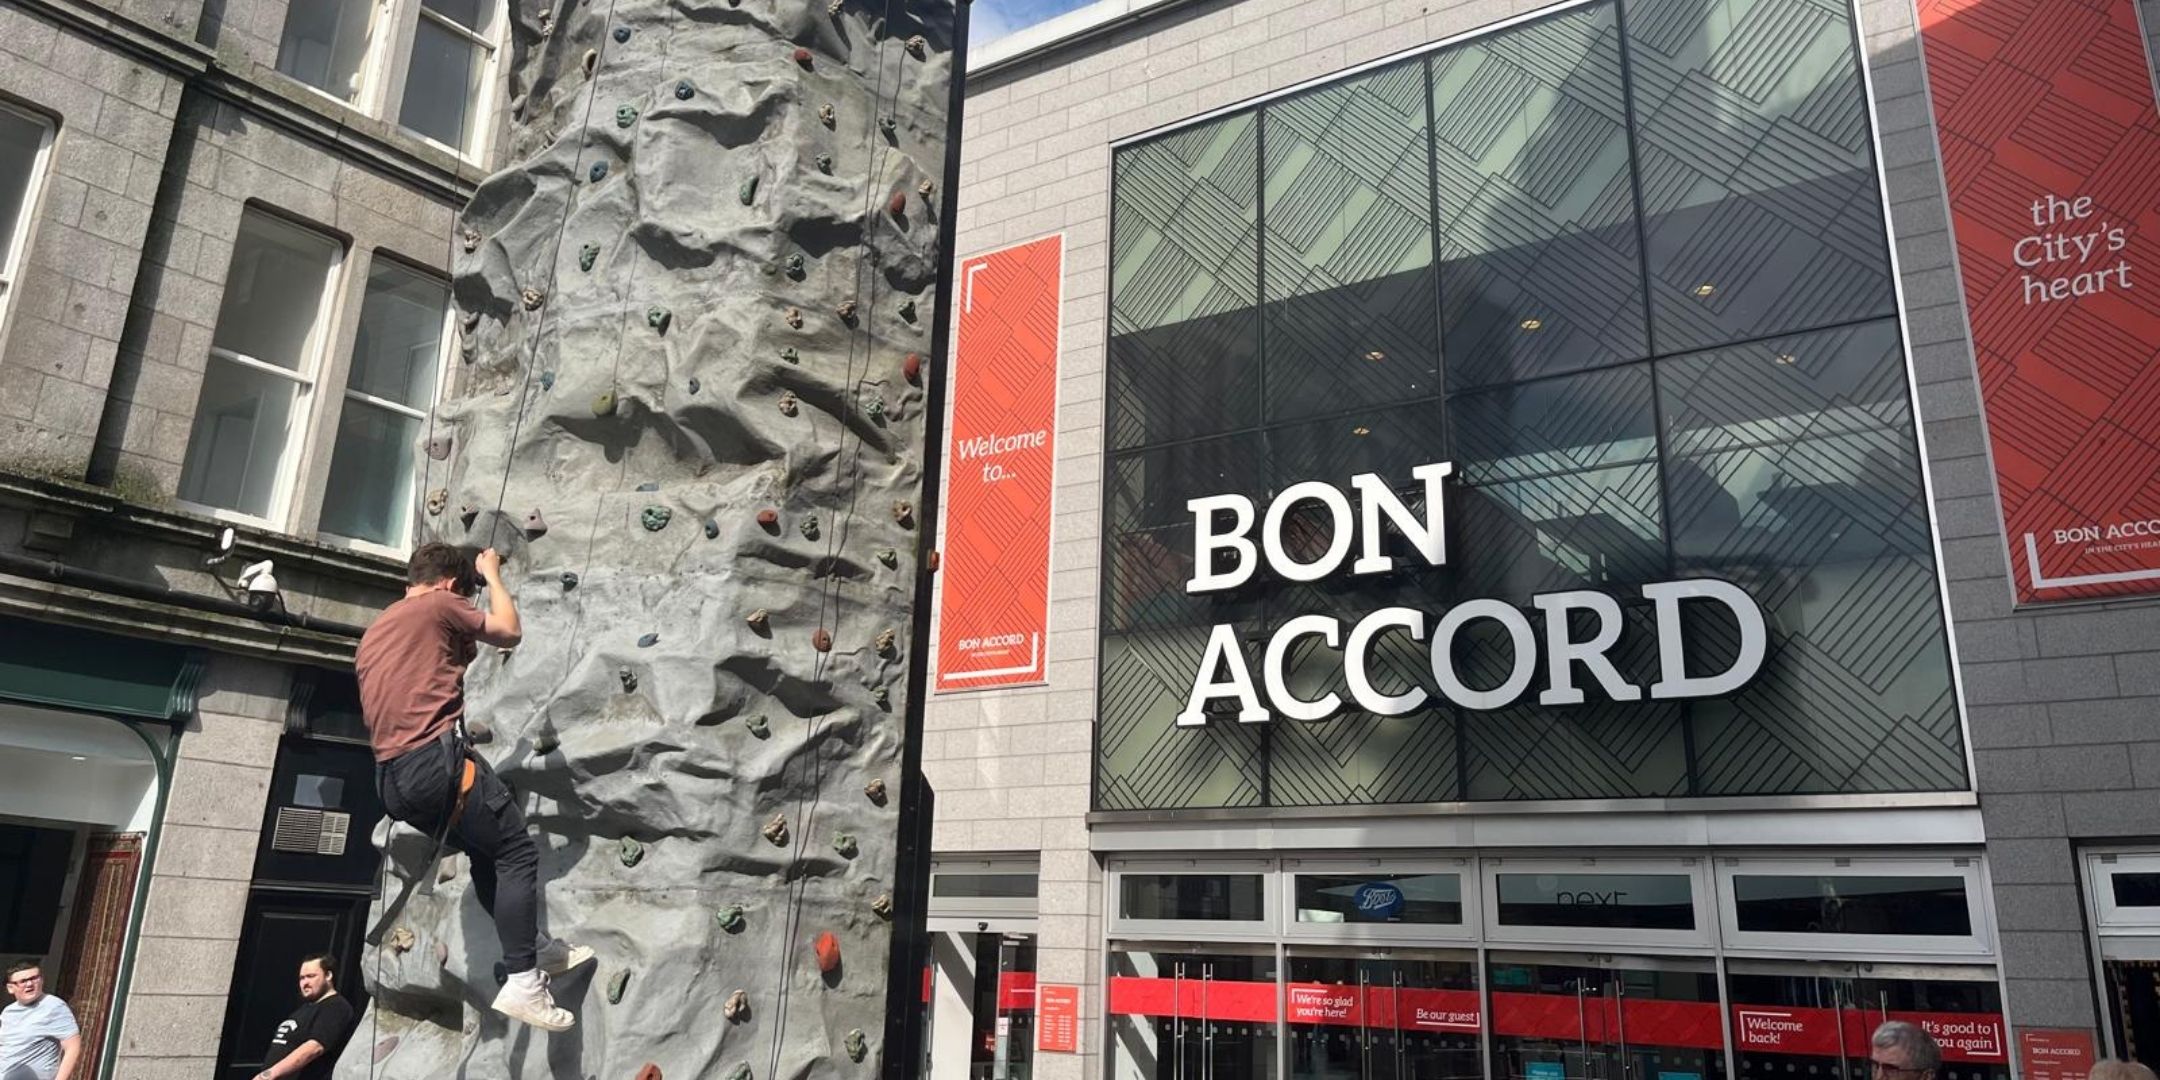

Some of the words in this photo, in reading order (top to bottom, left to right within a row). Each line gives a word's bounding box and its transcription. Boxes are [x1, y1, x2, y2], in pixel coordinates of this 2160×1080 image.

[2030, 194, 2093, 226] the
[2013, 222, 2126, 267] City's
[2021, 260, 2133, 305] heart
[958, 429, 1047, 460] Welcome
[982, 462, 1016, 483] to...
[1185, 460, 1454, 594] BON
[2053, 526, 2100, 545] BON
[2140, 540, 2160, 549] HEA
[959, 639, 980, 651] BON
[982, 633, 1025, 648] ACCORD
[1175, 577, 1769, 727] ACCORD
[1334, 996, 1354, 1007] glad
[1324, 1008, 1347, 1018] here!
[1416, 1008, 1429, 1019] Be
[1430, 1011, 1447, 1020] our
[1448, 1011, 1475, 1023] guest
[1747, 1017, 1804, 1032] Welcome
[1942, 1022, 1975, 1036] good
[1977, 1024, 1991, 1034] to
[1748, 1030, 1780, 1044] back!
[1934, 1037, 1955, 1048] ou
[1956, 1037, 1993, 1051] again
